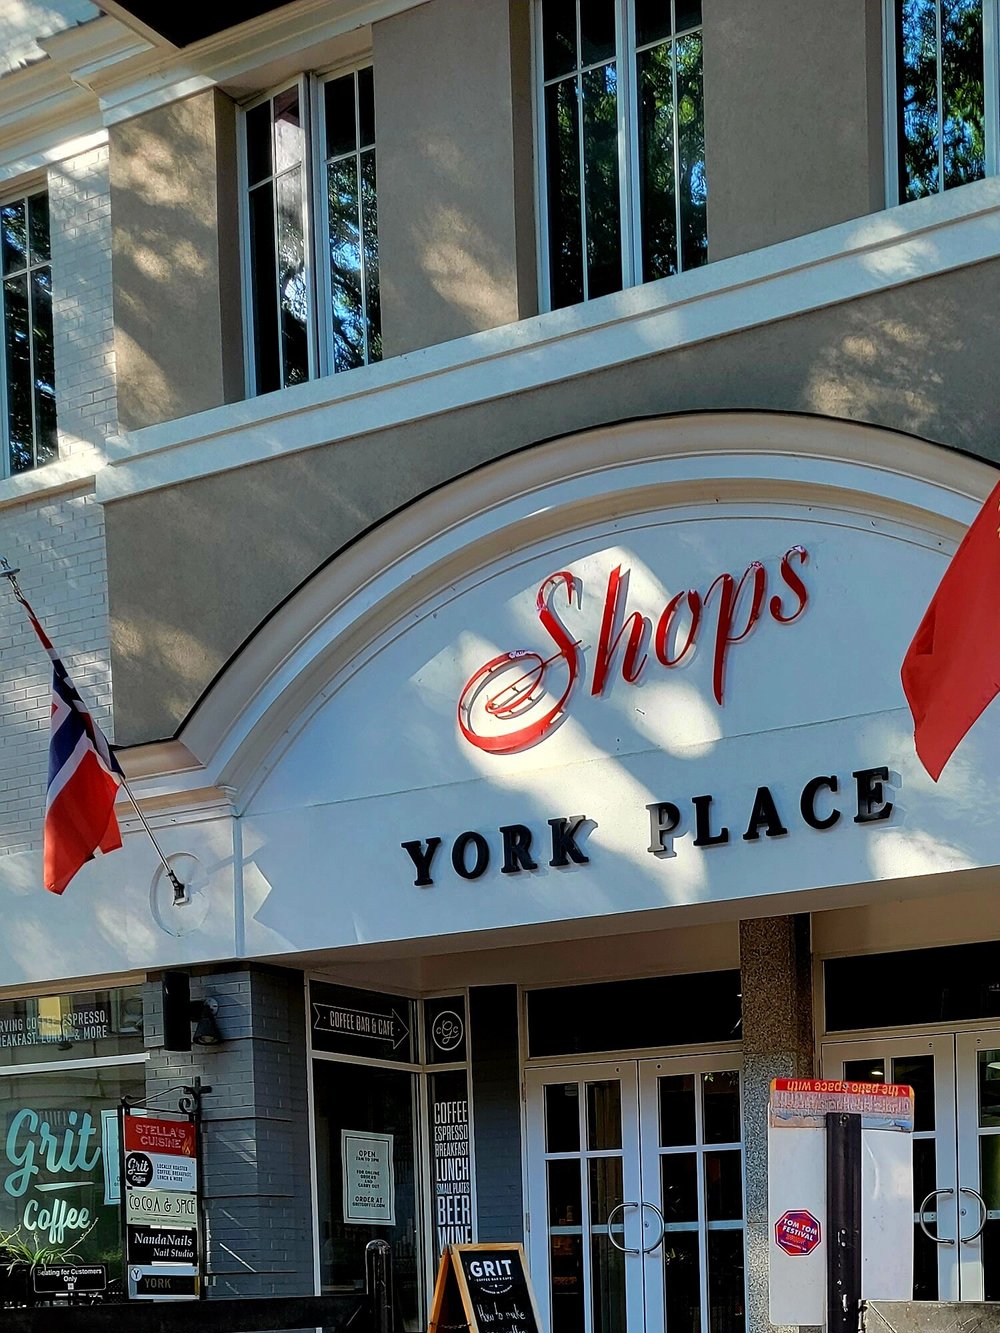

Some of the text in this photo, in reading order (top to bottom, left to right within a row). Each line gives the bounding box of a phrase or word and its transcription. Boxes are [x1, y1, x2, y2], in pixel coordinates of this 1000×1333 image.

[457, 544, 809, 754] Shops
[401, 766, 894, 887] YORK PLACE
[83, 1025, 107, 1039] MORE
[329, 1010, 355, 1030] COFFEE
[356, 1015, 370, 1033] BAR
[378, 1019, 394, 1036] CAFE
[787, 1080, 811, 1091] with
[434, 1101, 467, 1124] COFFEE
[135, 1124, 186, 1139] STELLA'S
[434, 1124, 468, 1142] ESPRESSO
[140, 1136, 181, 1149] CUISINE
[435, 1141, 469, 1157] BREAKFAST
[4, 1108, 101, 1197] Grit
[127, 1158, 149, 1175] Grit
[436, 1158, 469, 1181] LUNCH
[129, 1193, 160, 1211] COCOA
[175, 1197, 195, 1215] SPICE
[437, 1194, 470, 1225] BEER
[23, 1199, 91, 1244] Coffee
[783, 1218, 817, 1236] TOM TOM
[782, 1225, 814, 1242] FESTIVAL
[153, 1248, 194, 1258] Nail Studio
[470, 1260, 512, 1277] GRIT
[144, 1278, 171, 1288] YORK
